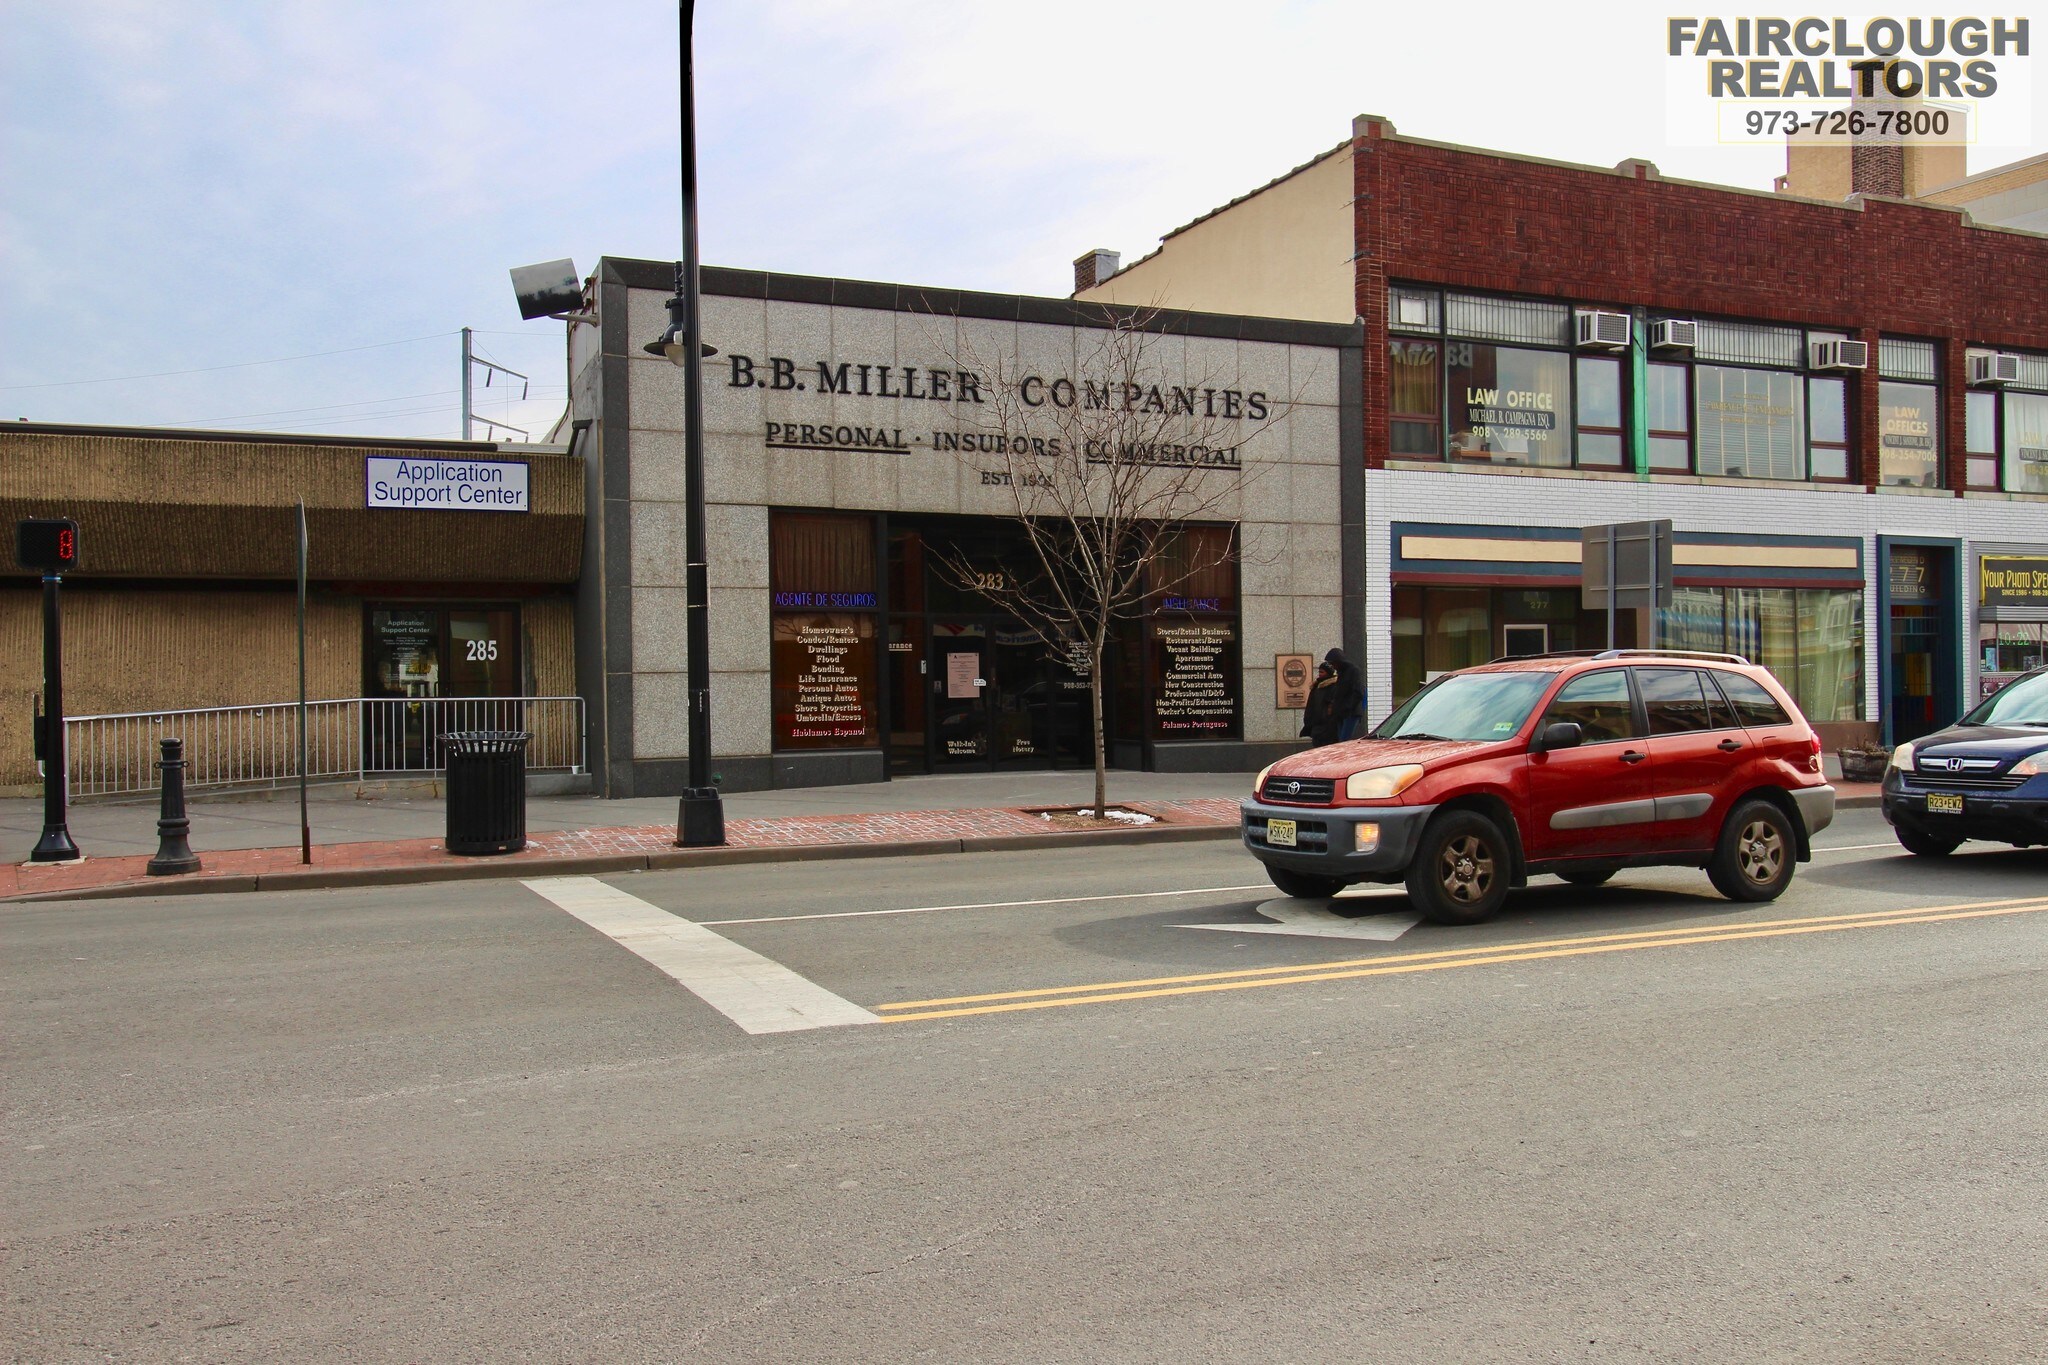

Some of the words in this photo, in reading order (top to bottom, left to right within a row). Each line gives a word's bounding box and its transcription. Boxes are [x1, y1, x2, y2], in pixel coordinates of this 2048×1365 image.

[728, 354, 805, 391] B.B.
[816, 361, 985, 404] MILLER
[1020, 375, 1269, 421] COMPANIES
[1466, 387, 1499, 405] LAW
[1507, 390, 1553, 410] OFFICE
[1469, 408, 1498, 424] MICHAEL
[1505, 411, 1536, 427] CAMPAGNA
[1894, 406, 1921, 419] LAW
[1886, 419, 1929, 434] OFFICES
[1472, 425, 1491, 438] 908
[1503, 427, 1548, 441] 289-5566
[765, 422, 908, 449] PERSONAL
[932, 431, 1061, 457] INSURORS
[1086, 439, 1242, 465] COMMERCIAL
[396, 460, 503, 485] Application
[374, 481, 451, 506] Support
[458, 484, 522, 504] Center
[59, 529, 73, 559] 8
[1890, 566, 1925, 582] 77
[1983, 569, 2005, 588] YOUR
[2006, 570, 2031, 588] PHOTO
[977, 572, 1004, 590] 283
[775, 592, 812, 607] AGENTE
[815, 593, 828, 607] DE
[830, 593, 877, 607] SEGUROS
[387, 620, 425, 628] Application
[802, 626, 854, 634] Homeowner's
[1157, 627, 1200, 636] Stores/Retail
[1202, 628, 1231, 636] Business
[797, 635, 859, 645] Condos/Renters
[1165, 637, 1223, 645] Restaurants/Bars
[1998, 631, 2030, 646] 10:22
[466, 640, 498, 661] 285
[807, 646, 848, 655] Dwellings
[1190, 645, 1222, 655] Buildings
[816, 655, 840, 663] Flood
[1175, 655, 1214, 663] Apartments
[811, 665, 845, 674] Bonding
[798, 674, 816, 683] Life
[818, 674, 858, 683] Insurance
[1166, 672, 1206, 680] Commercial
[798, 684, 833, 692] Personal
[835, 684, 858, 692] Autos
[1165, 681, 1179, 689] New
[800, 694, 832, 703] Antique
[834, 694, 857, 702] Autos
[794, 704, 818, 712] Shore
[820, 704, 862, 713] Properties
[1157, 708, 1185, 716] Worker's
[1186, 707, 1233, 717] Compensation
[796, 713, 862, 722] Umbrella/Excess
[792, 728, 832, 738] Hablamos
[948, 747, 976, 755] Welcome
